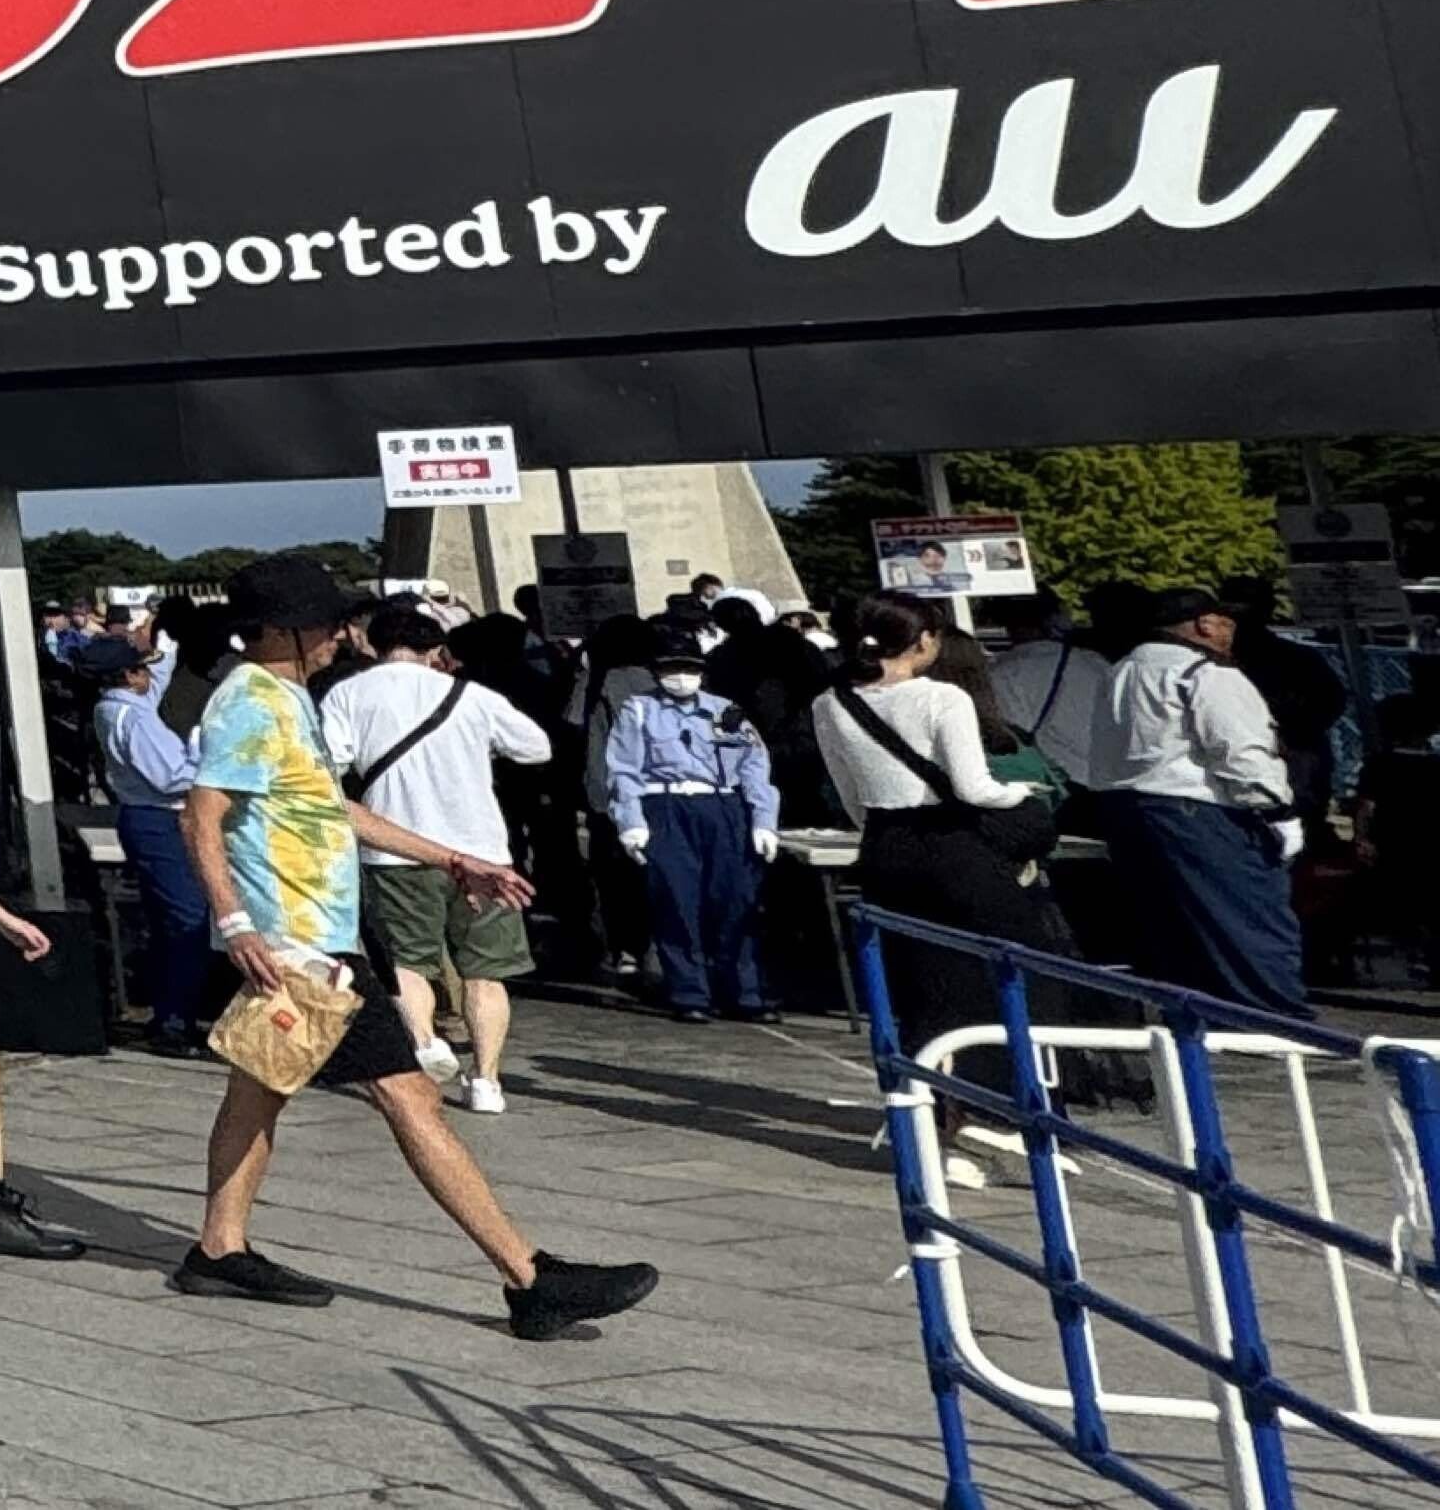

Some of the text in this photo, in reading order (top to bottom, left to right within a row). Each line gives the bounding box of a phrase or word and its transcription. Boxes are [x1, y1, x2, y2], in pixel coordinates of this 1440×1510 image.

[525, 193, 668, 275] by
[743, 63, 1339, 258] au
[386, 435, 505, 455] 手荷物検査
